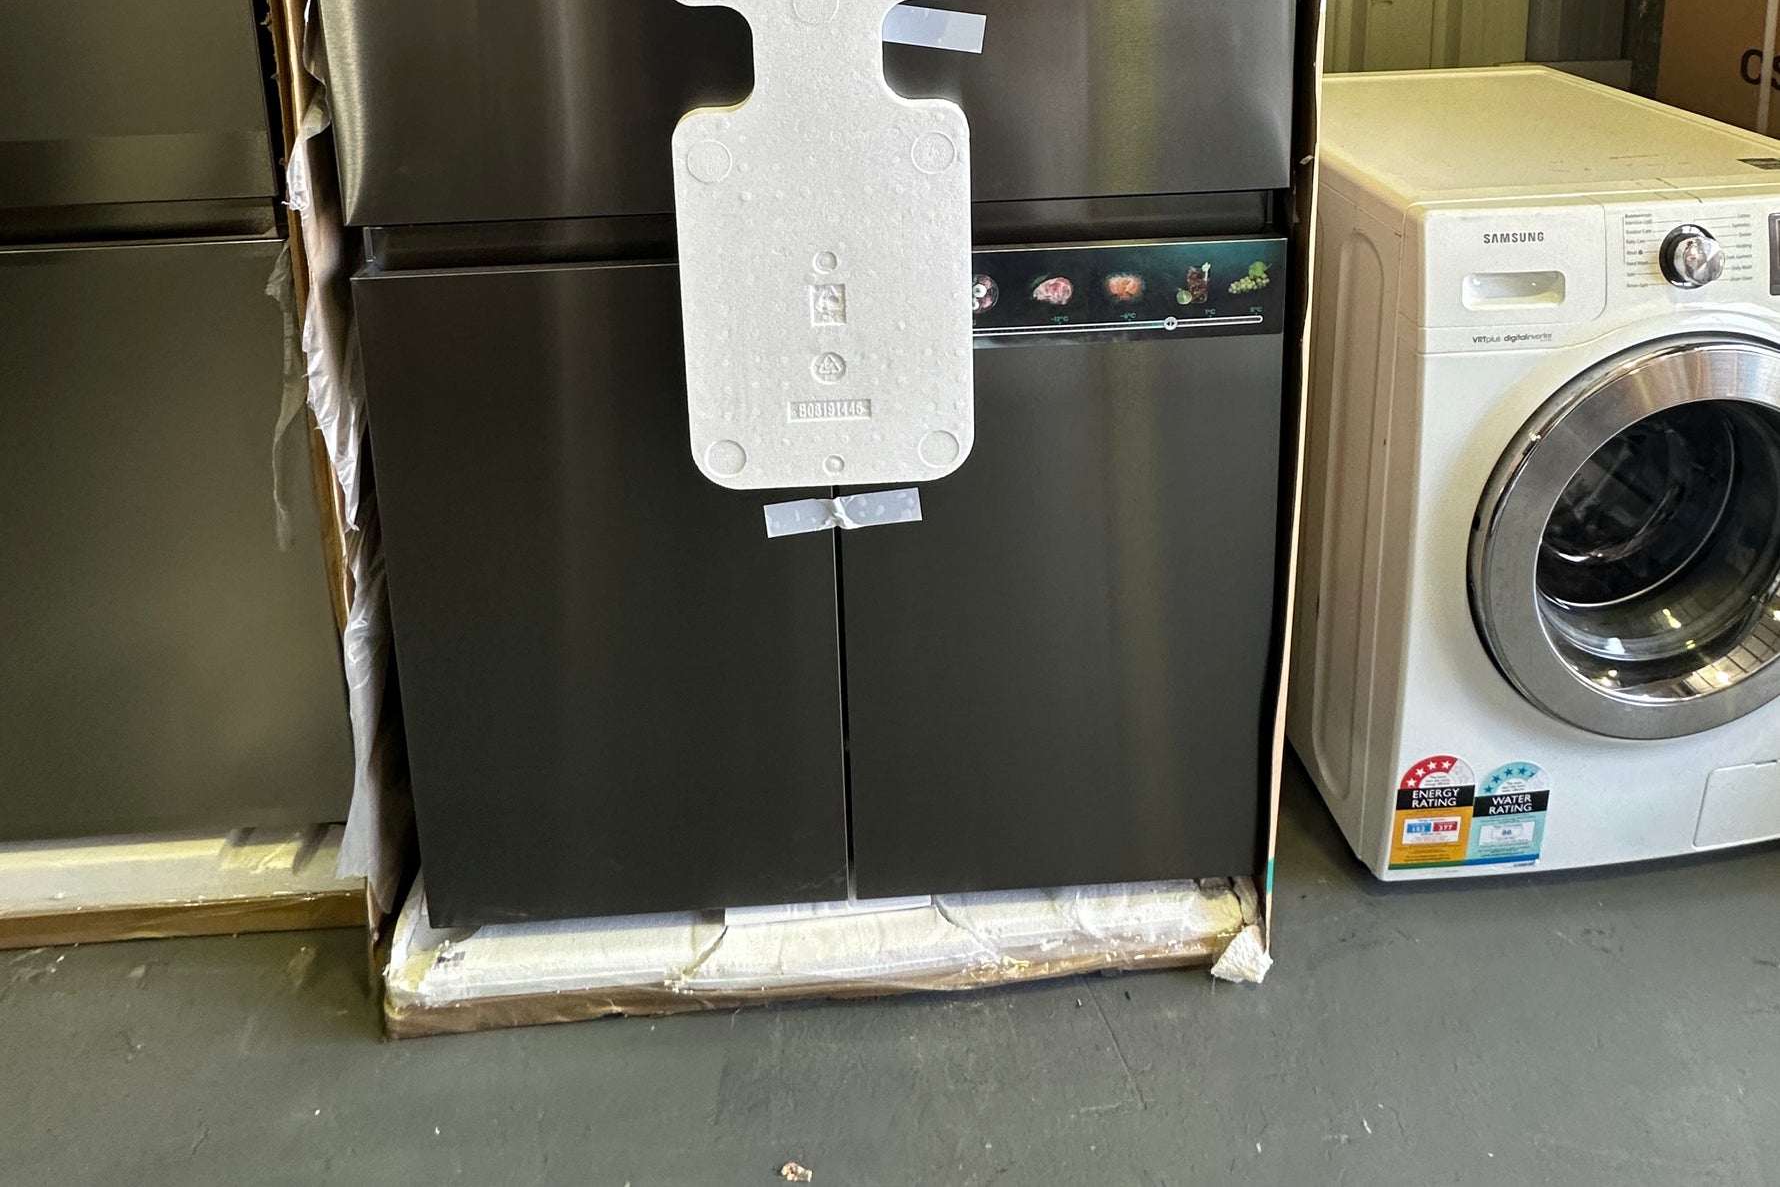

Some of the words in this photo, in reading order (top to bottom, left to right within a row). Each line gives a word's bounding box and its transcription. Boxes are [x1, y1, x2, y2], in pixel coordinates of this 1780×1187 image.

[1483, 231, 1545, 244] SAMSUNG
[1472, 336, 1501, 344] VRTplus
[1412, 788, 1460, 799] ENERGY
[1412, 797, 1457, 808] RATING
[1492, 794, 1532, 805] WATER
[1489, 803, 1533, 814] RATING
